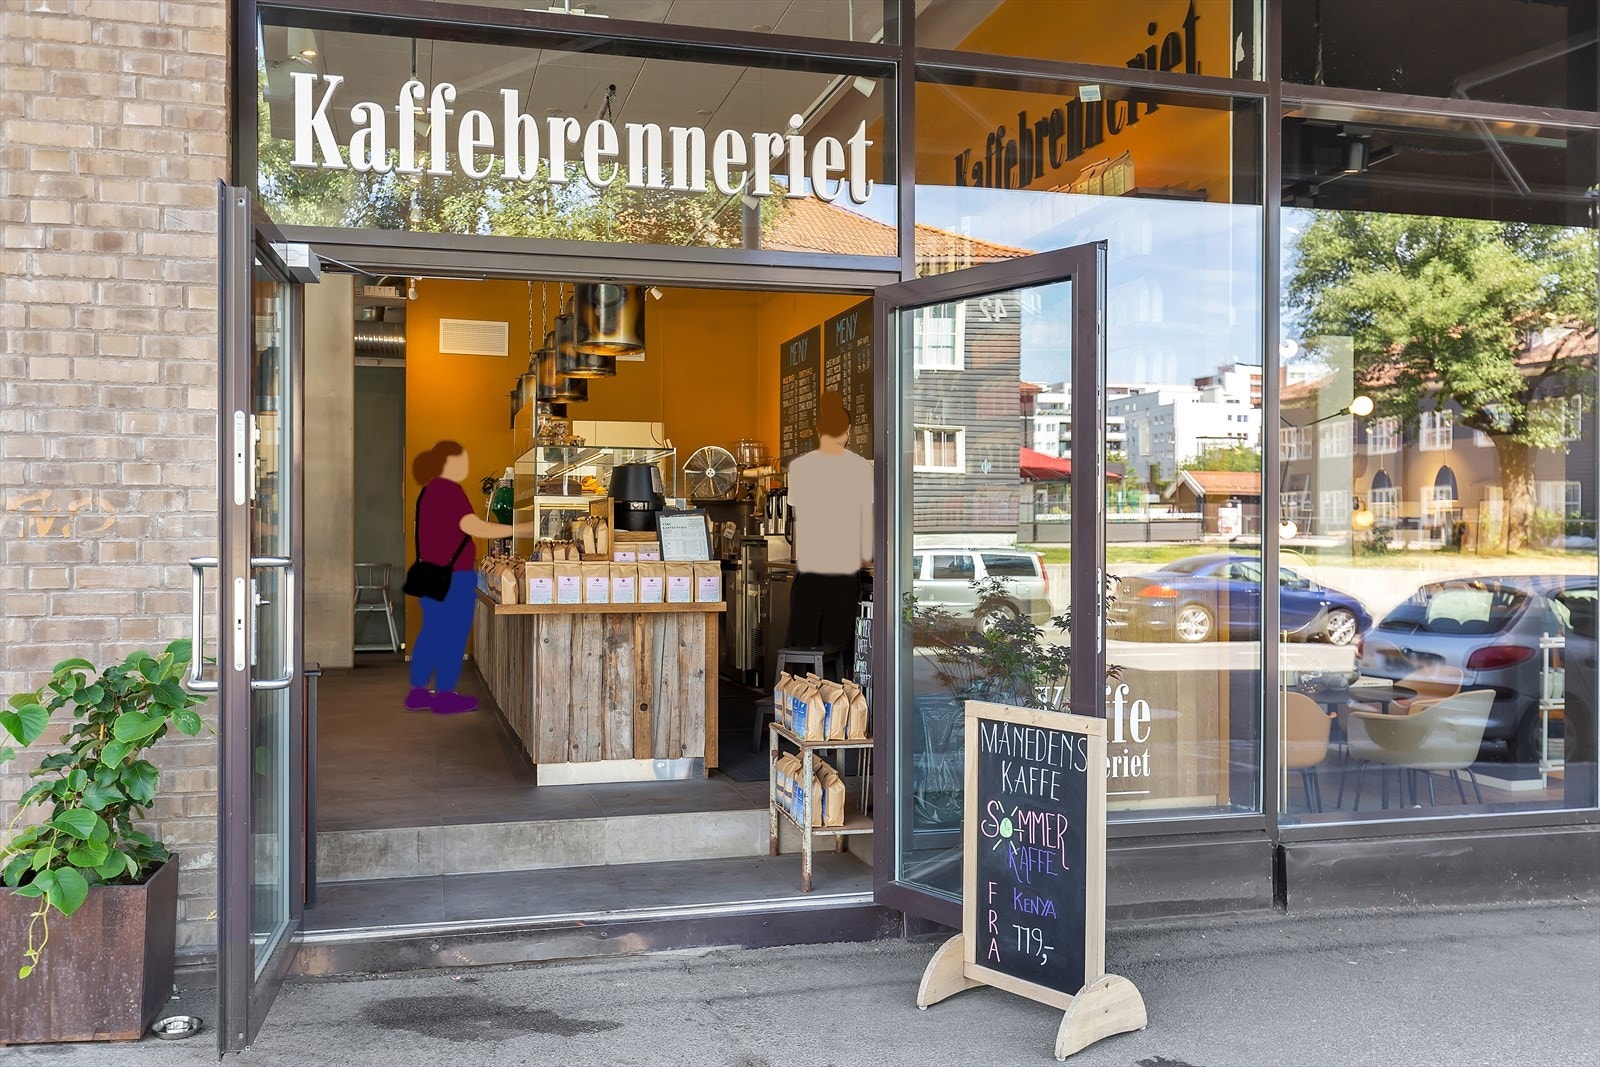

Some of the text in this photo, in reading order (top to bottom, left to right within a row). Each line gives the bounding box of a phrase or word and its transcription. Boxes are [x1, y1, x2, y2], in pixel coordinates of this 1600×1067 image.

[289, 71, 874, 204] Kaffebrenneriet
[836, 312, 858, 347] MENY
[789, 337, 809, 368] MENY
[980, 721, 1088, 772] MÅNEDENS
[1001, 760, 1061, 801] KAFFE
[981, 800, 1069, 870] SOMMER
[1008, 843, 1058, 884] KAFFE
[1013, 887, 1057, 919] KENYA
